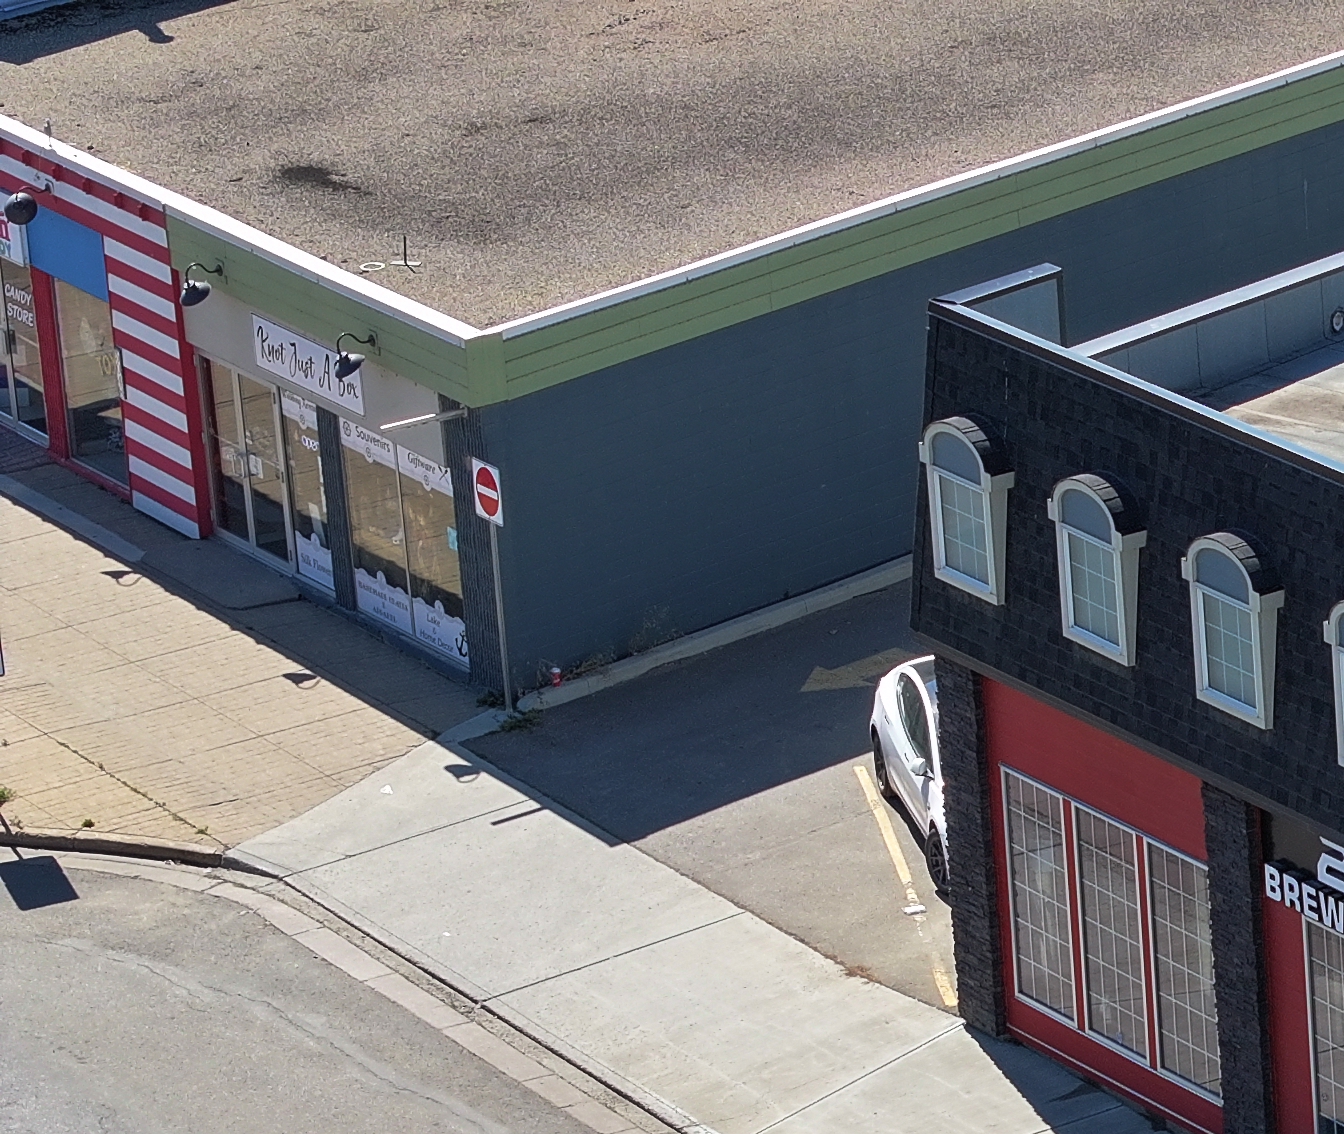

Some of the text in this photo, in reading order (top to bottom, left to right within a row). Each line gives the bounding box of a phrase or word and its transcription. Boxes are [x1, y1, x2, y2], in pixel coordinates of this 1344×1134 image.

[4, 283, 32, 306] CANDY
[7, 302, 34, 327] STORE
[257, 325, 286, 365] Knot
[289, 341, 316, 380] Just
[318, 354, 331, 392] A
[355, 426, 391, 453] Souvenirs
[407, 452, 437, 475] Giftware
[426, 613, 441, 626] Lake
[420, 629, 437, 645] Home
